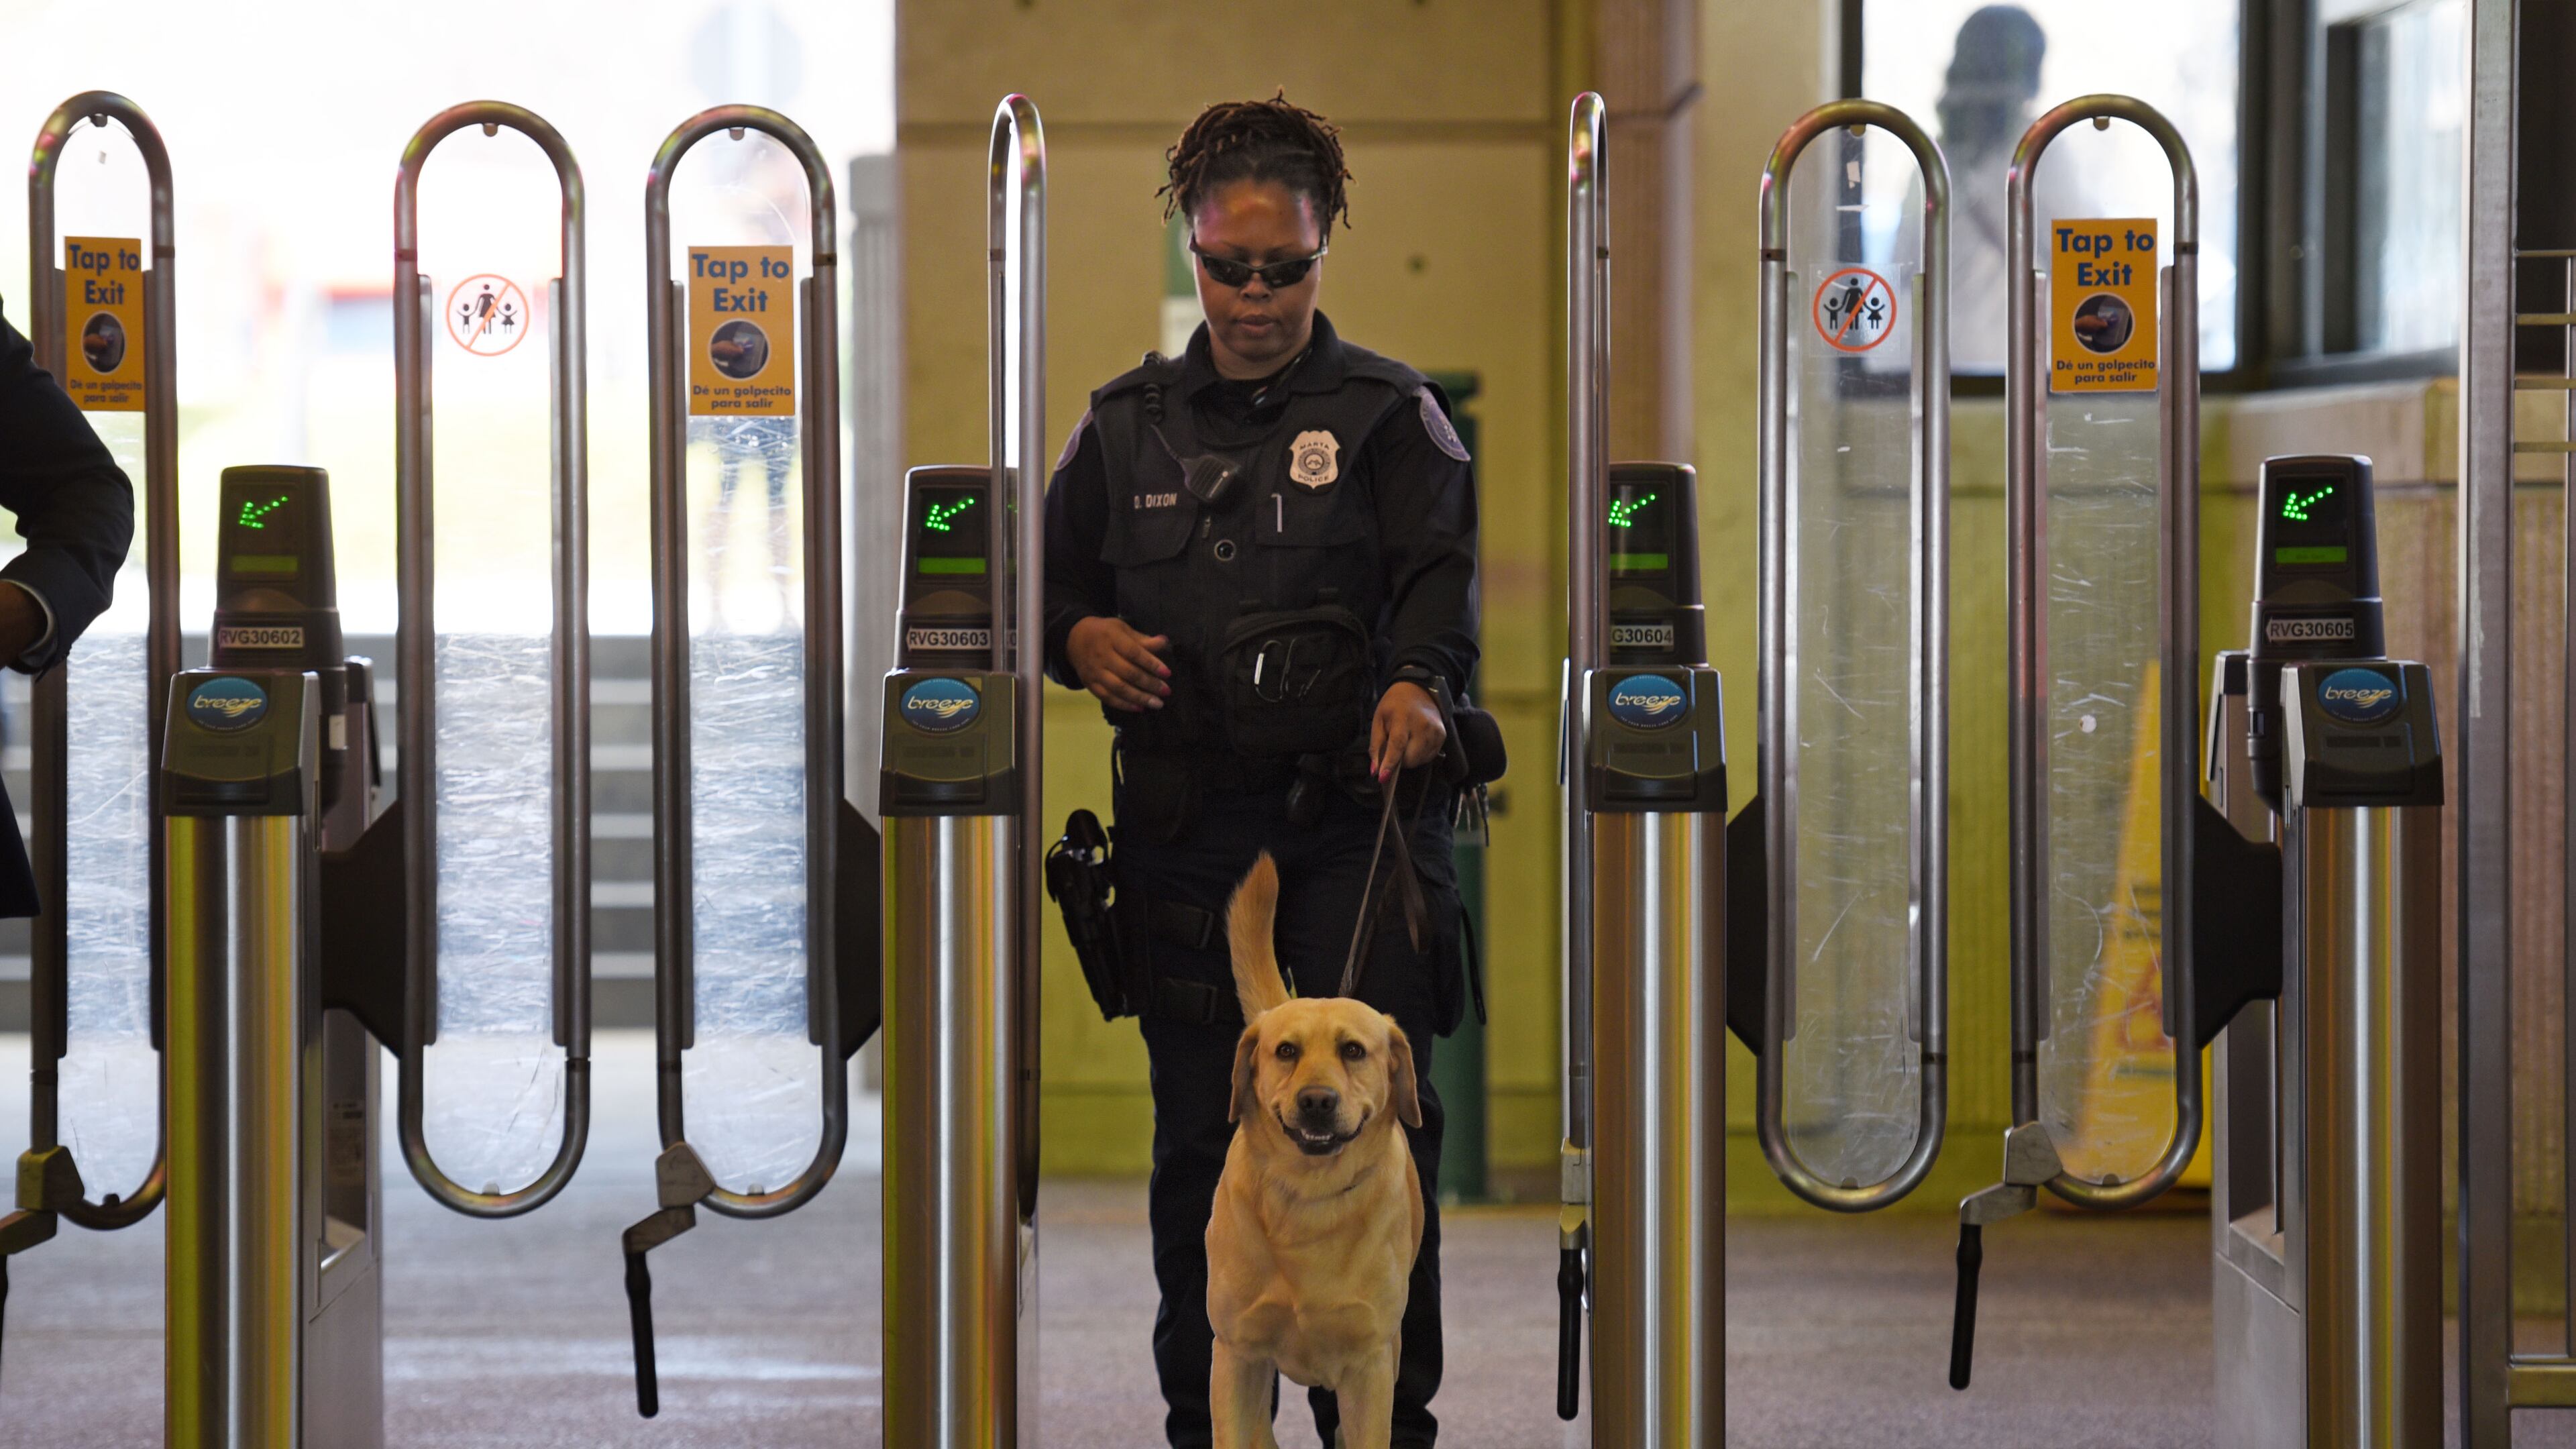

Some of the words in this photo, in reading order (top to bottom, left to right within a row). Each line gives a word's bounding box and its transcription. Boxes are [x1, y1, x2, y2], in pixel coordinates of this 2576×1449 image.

[2056, 229, 2113, 258] Tap
[2125, 229, 2155, 251] to
[68, 244, 111, 276] Tap
[118, 248, 140, 271] to
[692, 254, 749, 284] Tap
[760, 256, 789, 278] to
[2078, 261, 2133, 286] Exit
[85, 279, 125, 305] Exit
[713, 287, 768, 312] Exit
[2056, 360, 2073, 370] Dé
[2098, 360, 2155, 372] golpecito
[86, 382, 97, 390] un
[101, 379, 142, 392] golpecito
[2075, 374, 2105, 384] para
[2109, 372, 2137, 382] salir
[84, 394, 106, 405] para
[109, 392, 129, 402] salir
[694, 385, 709, 395] Dé
[734, 385, 791, 397] golpecito
[711, 400, 741, 410] para
[745, 398, 773, 408] salir
[1299, 442, 1330, 450] MARTA
[1298, 474, 1328, 482] POLICE
[1145, 492, 1178, 508] DIXON
[219, 629, 301, 645] RVG30602
[1611, 628, 1674, 643] G30604
[2269, 622, 2353, 637] RVG30605
[908, 631, 989, 646] RVG30603
[1615, 692, 1682, 713] breeze
[2324, 686, 2393, 707] breeze
[193, 694, 263, 716] breeze
[908, 695, 974, 716] breeze
